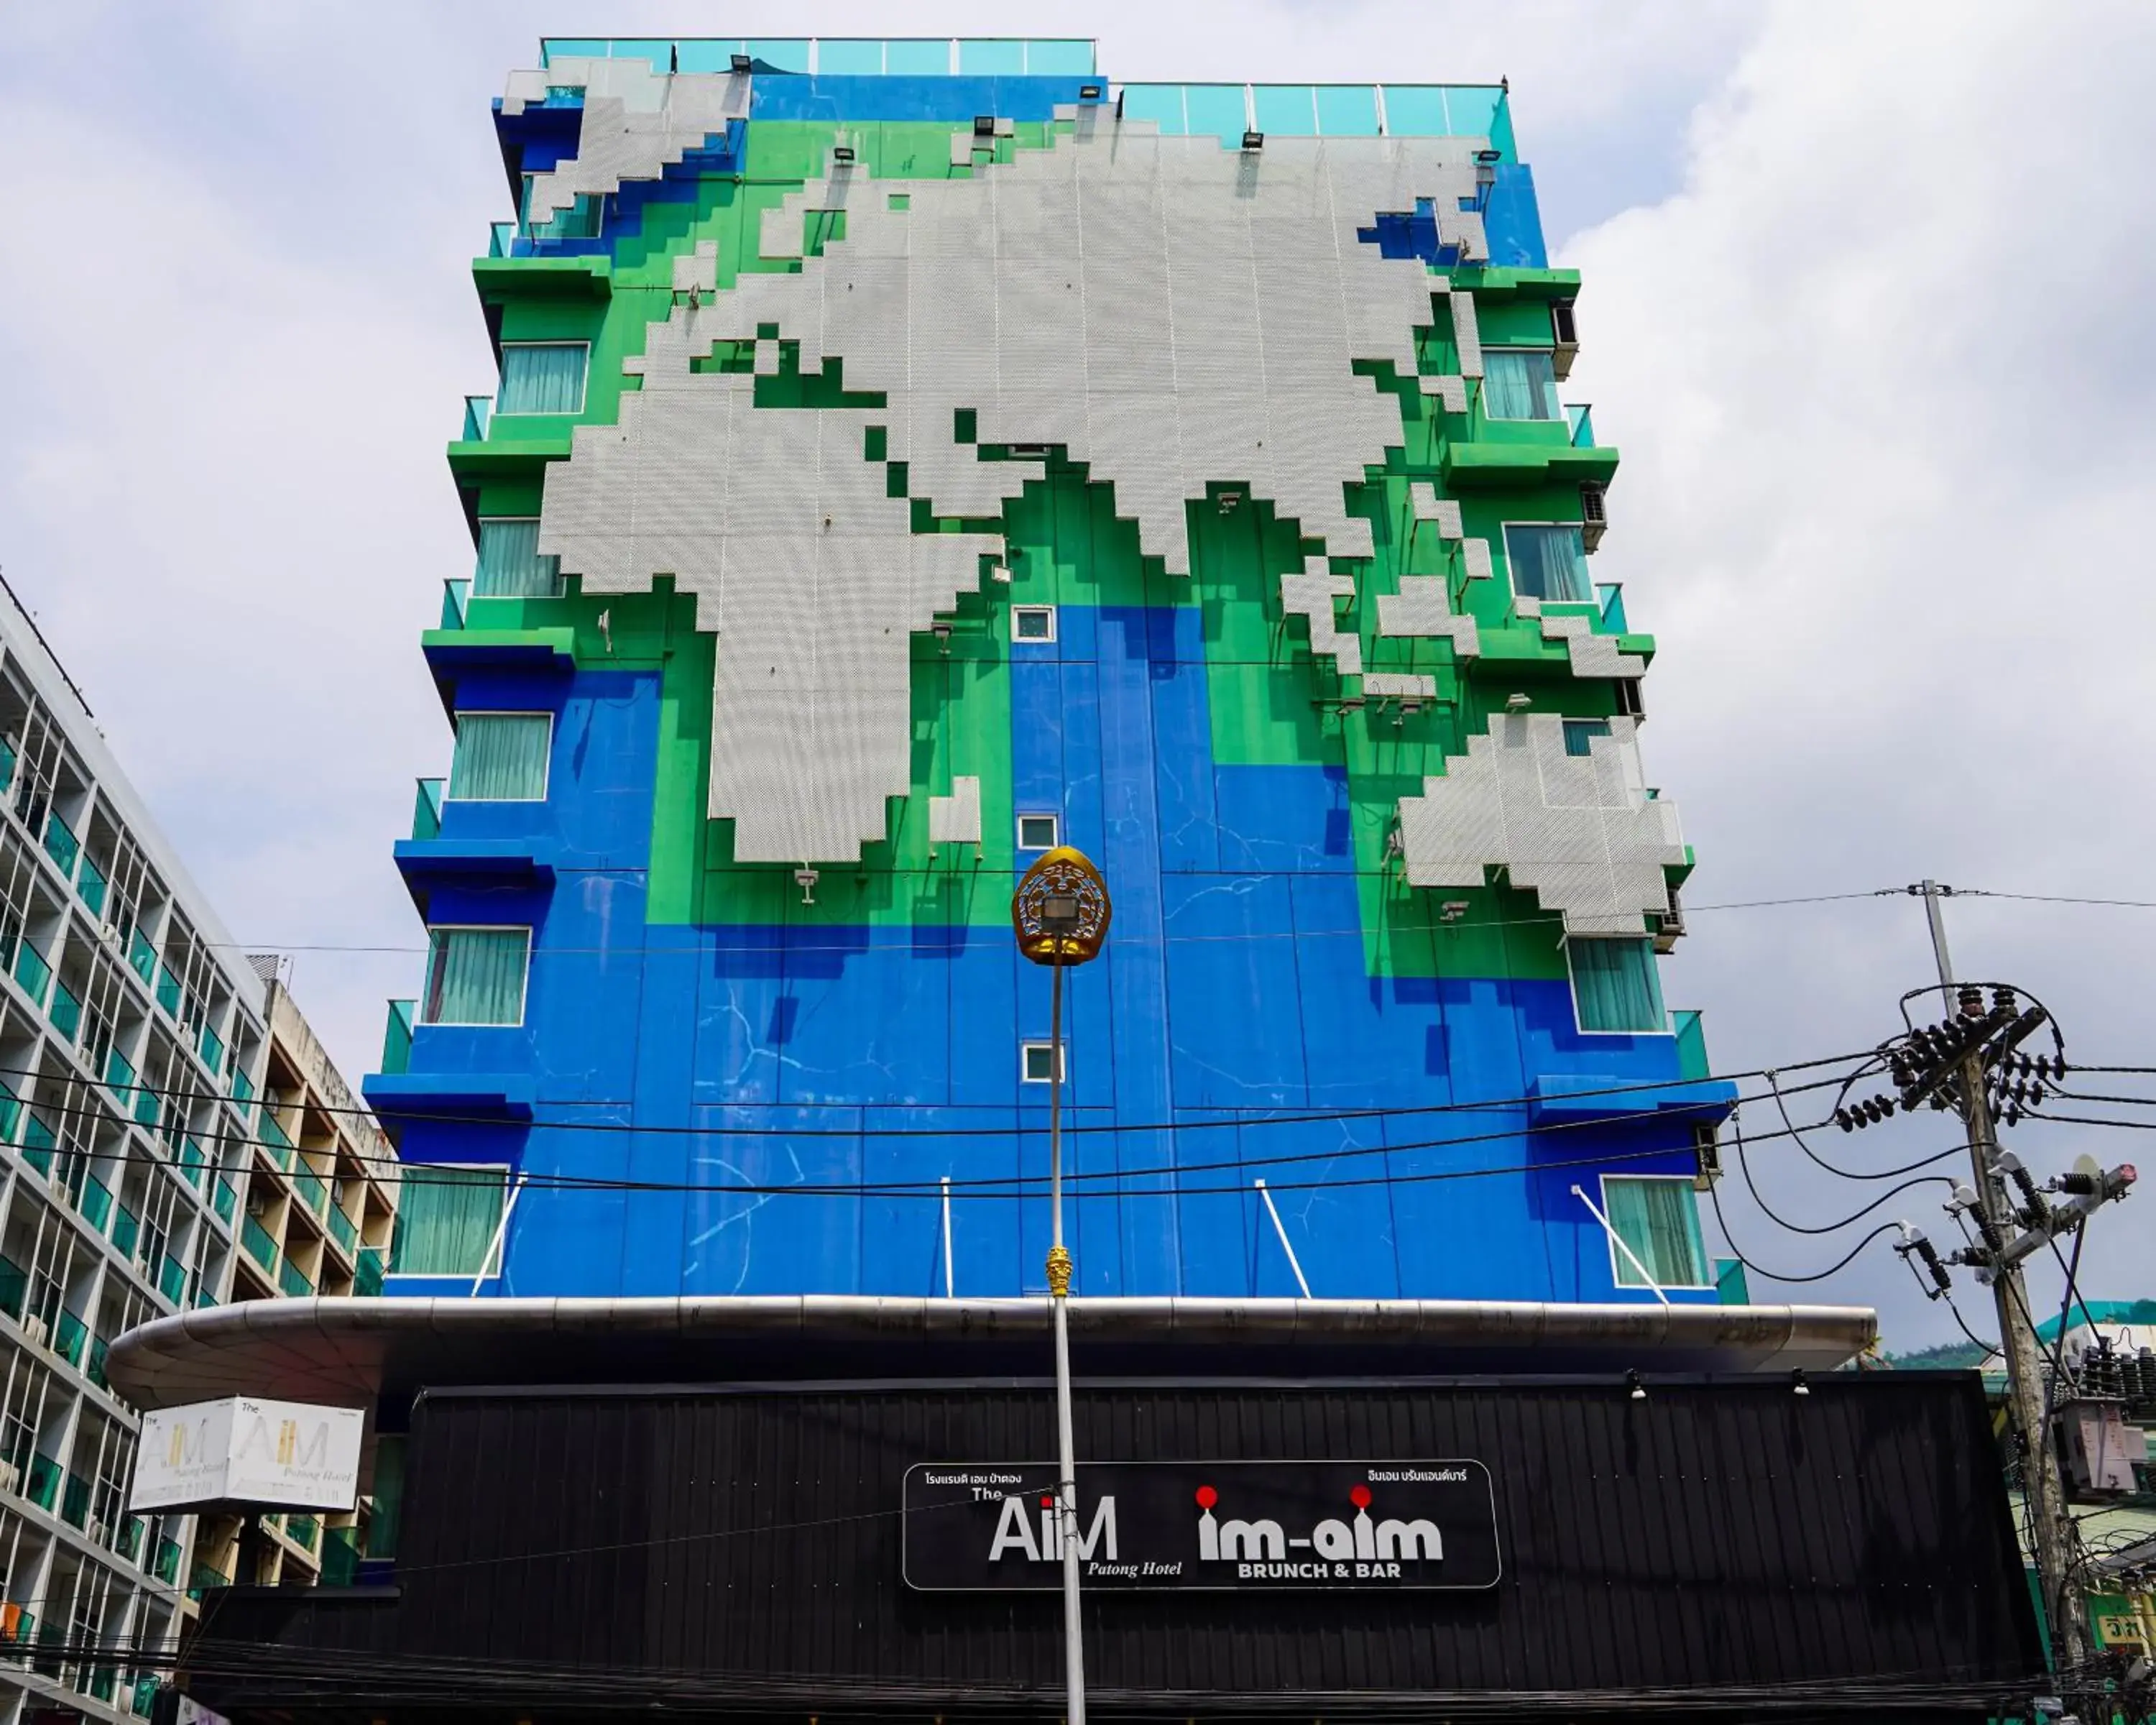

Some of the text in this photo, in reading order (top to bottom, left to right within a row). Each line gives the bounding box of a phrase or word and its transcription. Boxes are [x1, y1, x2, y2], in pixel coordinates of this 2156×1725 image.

[972, 1487, 1003, 1501] The
[1087, 1561, 1182, 1578] Patong Hotel
[1238, 1563, 1401, 1578] BRUNCH & BAR
